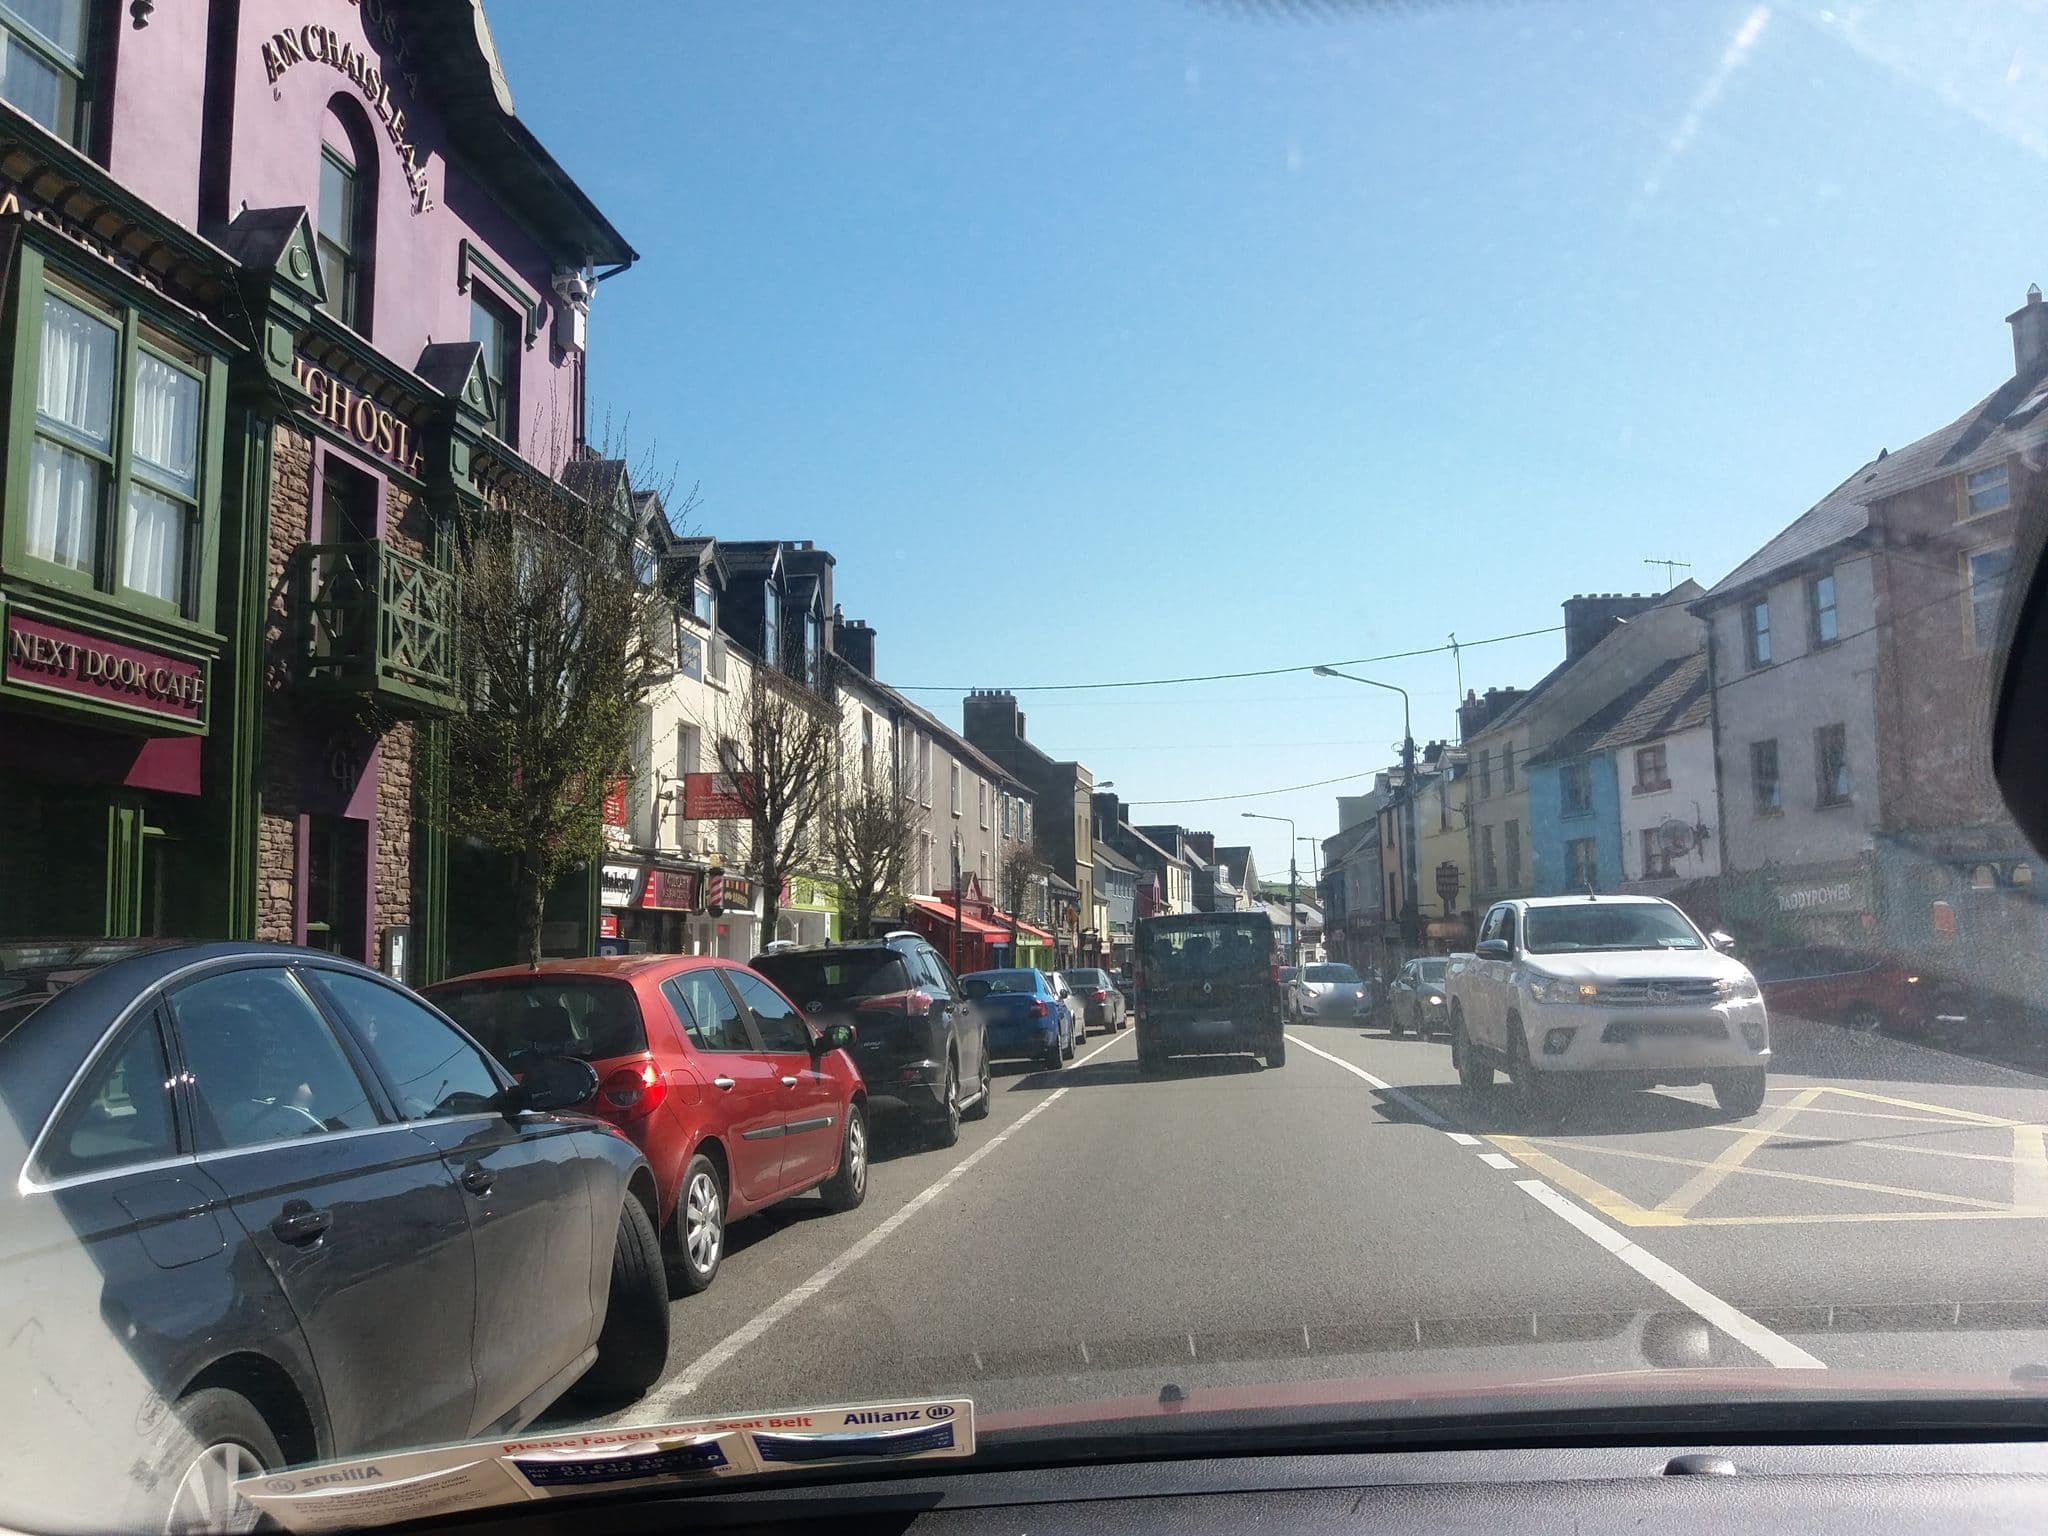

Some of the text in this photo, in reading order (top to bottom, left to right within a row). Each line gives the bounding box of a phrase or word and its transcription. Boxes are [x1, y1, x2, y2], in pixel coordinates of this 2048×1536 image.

[11, 629, 81, 671] NEXT
[86, 648, 147, 689] DOOR
[843, 1408, 920, 1425] Allianz
[503, 1438, 577, 1453] Please
[581, 1431, 653, 1446] Fasten
[769, 1417, 812, 1429] Belt
